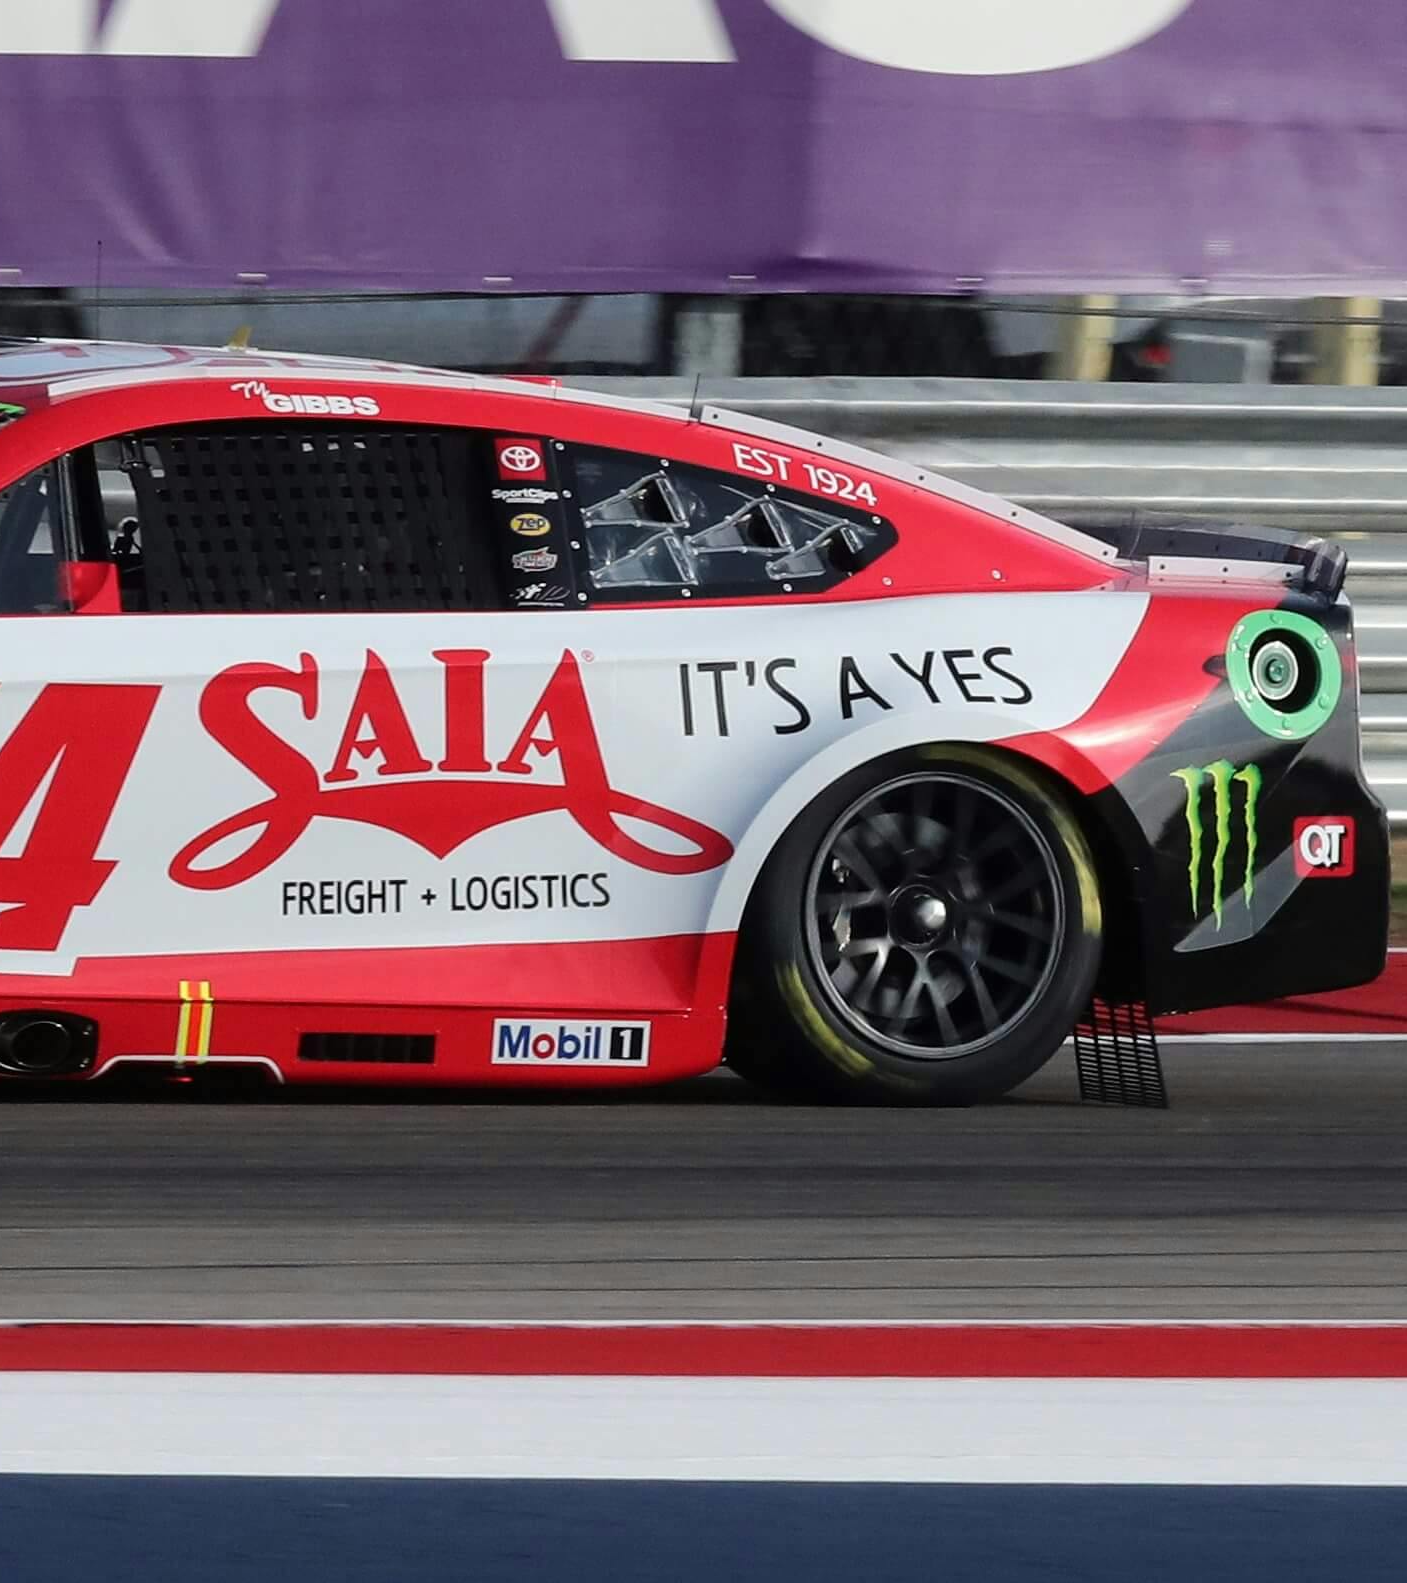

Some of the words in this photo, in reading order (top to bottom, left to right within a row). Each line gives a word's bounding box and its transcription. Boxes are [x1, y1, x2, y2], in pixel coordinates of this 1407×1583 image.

[265, 394, 380, 416] GIBBS
[732, 442, 791, 480] EST
[803, 464, 877, 506] 1924
[680, 658, 811, 737] IT'S
[839, 656, 893, 719] A
[890, 647, 1032, 704] YES
[168, 648, 735, 890] SAIA
[1299, 824, 1346, 867] QT
[282, 879, 407, 915] FREIGHT
[421, 888, 437, 906] +
[451, 873, 610, 911] LOGISTICS
[498, 1025, 601, 1060] Mobil
